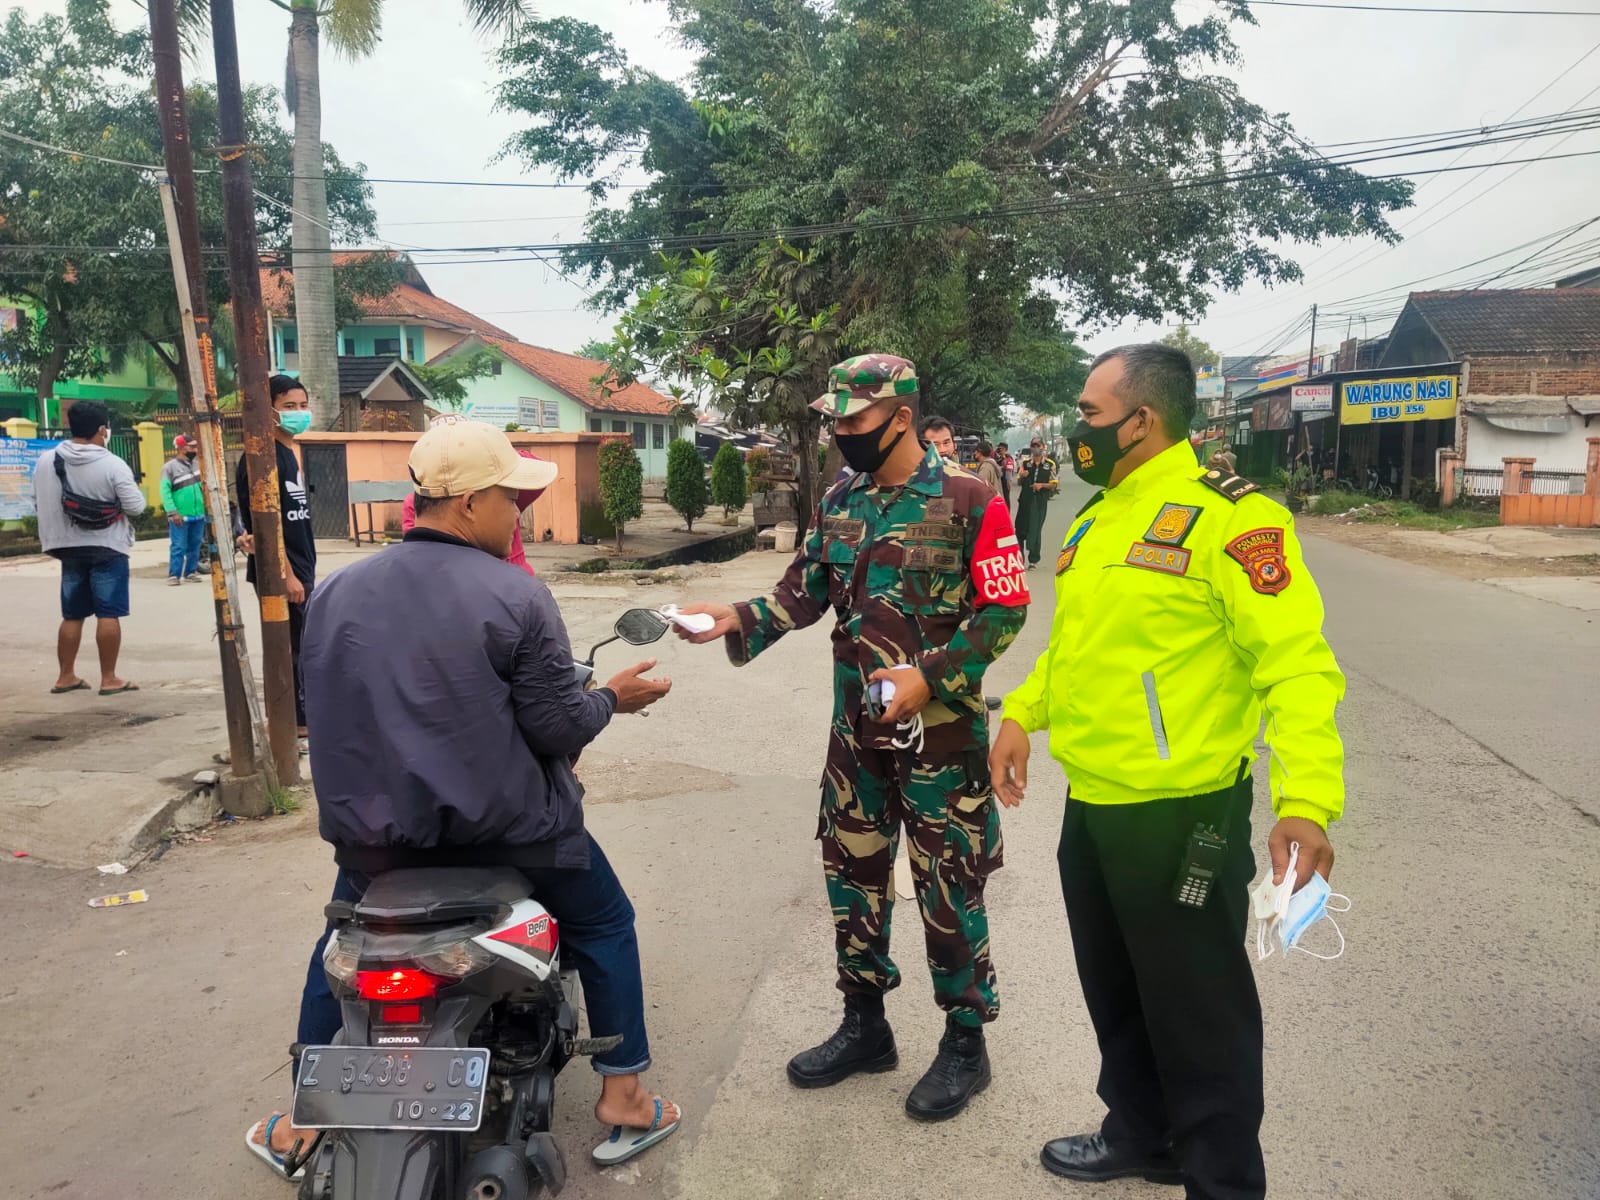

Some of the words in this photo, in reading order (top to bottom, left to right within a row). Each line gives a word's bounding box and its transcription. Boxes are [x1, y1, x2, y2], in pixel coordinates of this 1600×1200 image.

[1346, 382, 1413, 405] WARUNG
[1416, 379, 1452, 400] NASI
[1371, 405, 1401, 420] IBU
[1405, 404, 1425, 414] 156
[1132, 547, 1184, 569] POLRI
[377, 1035, 420, 1044] HONDA
[302, 1054, 321, 1087] Z
